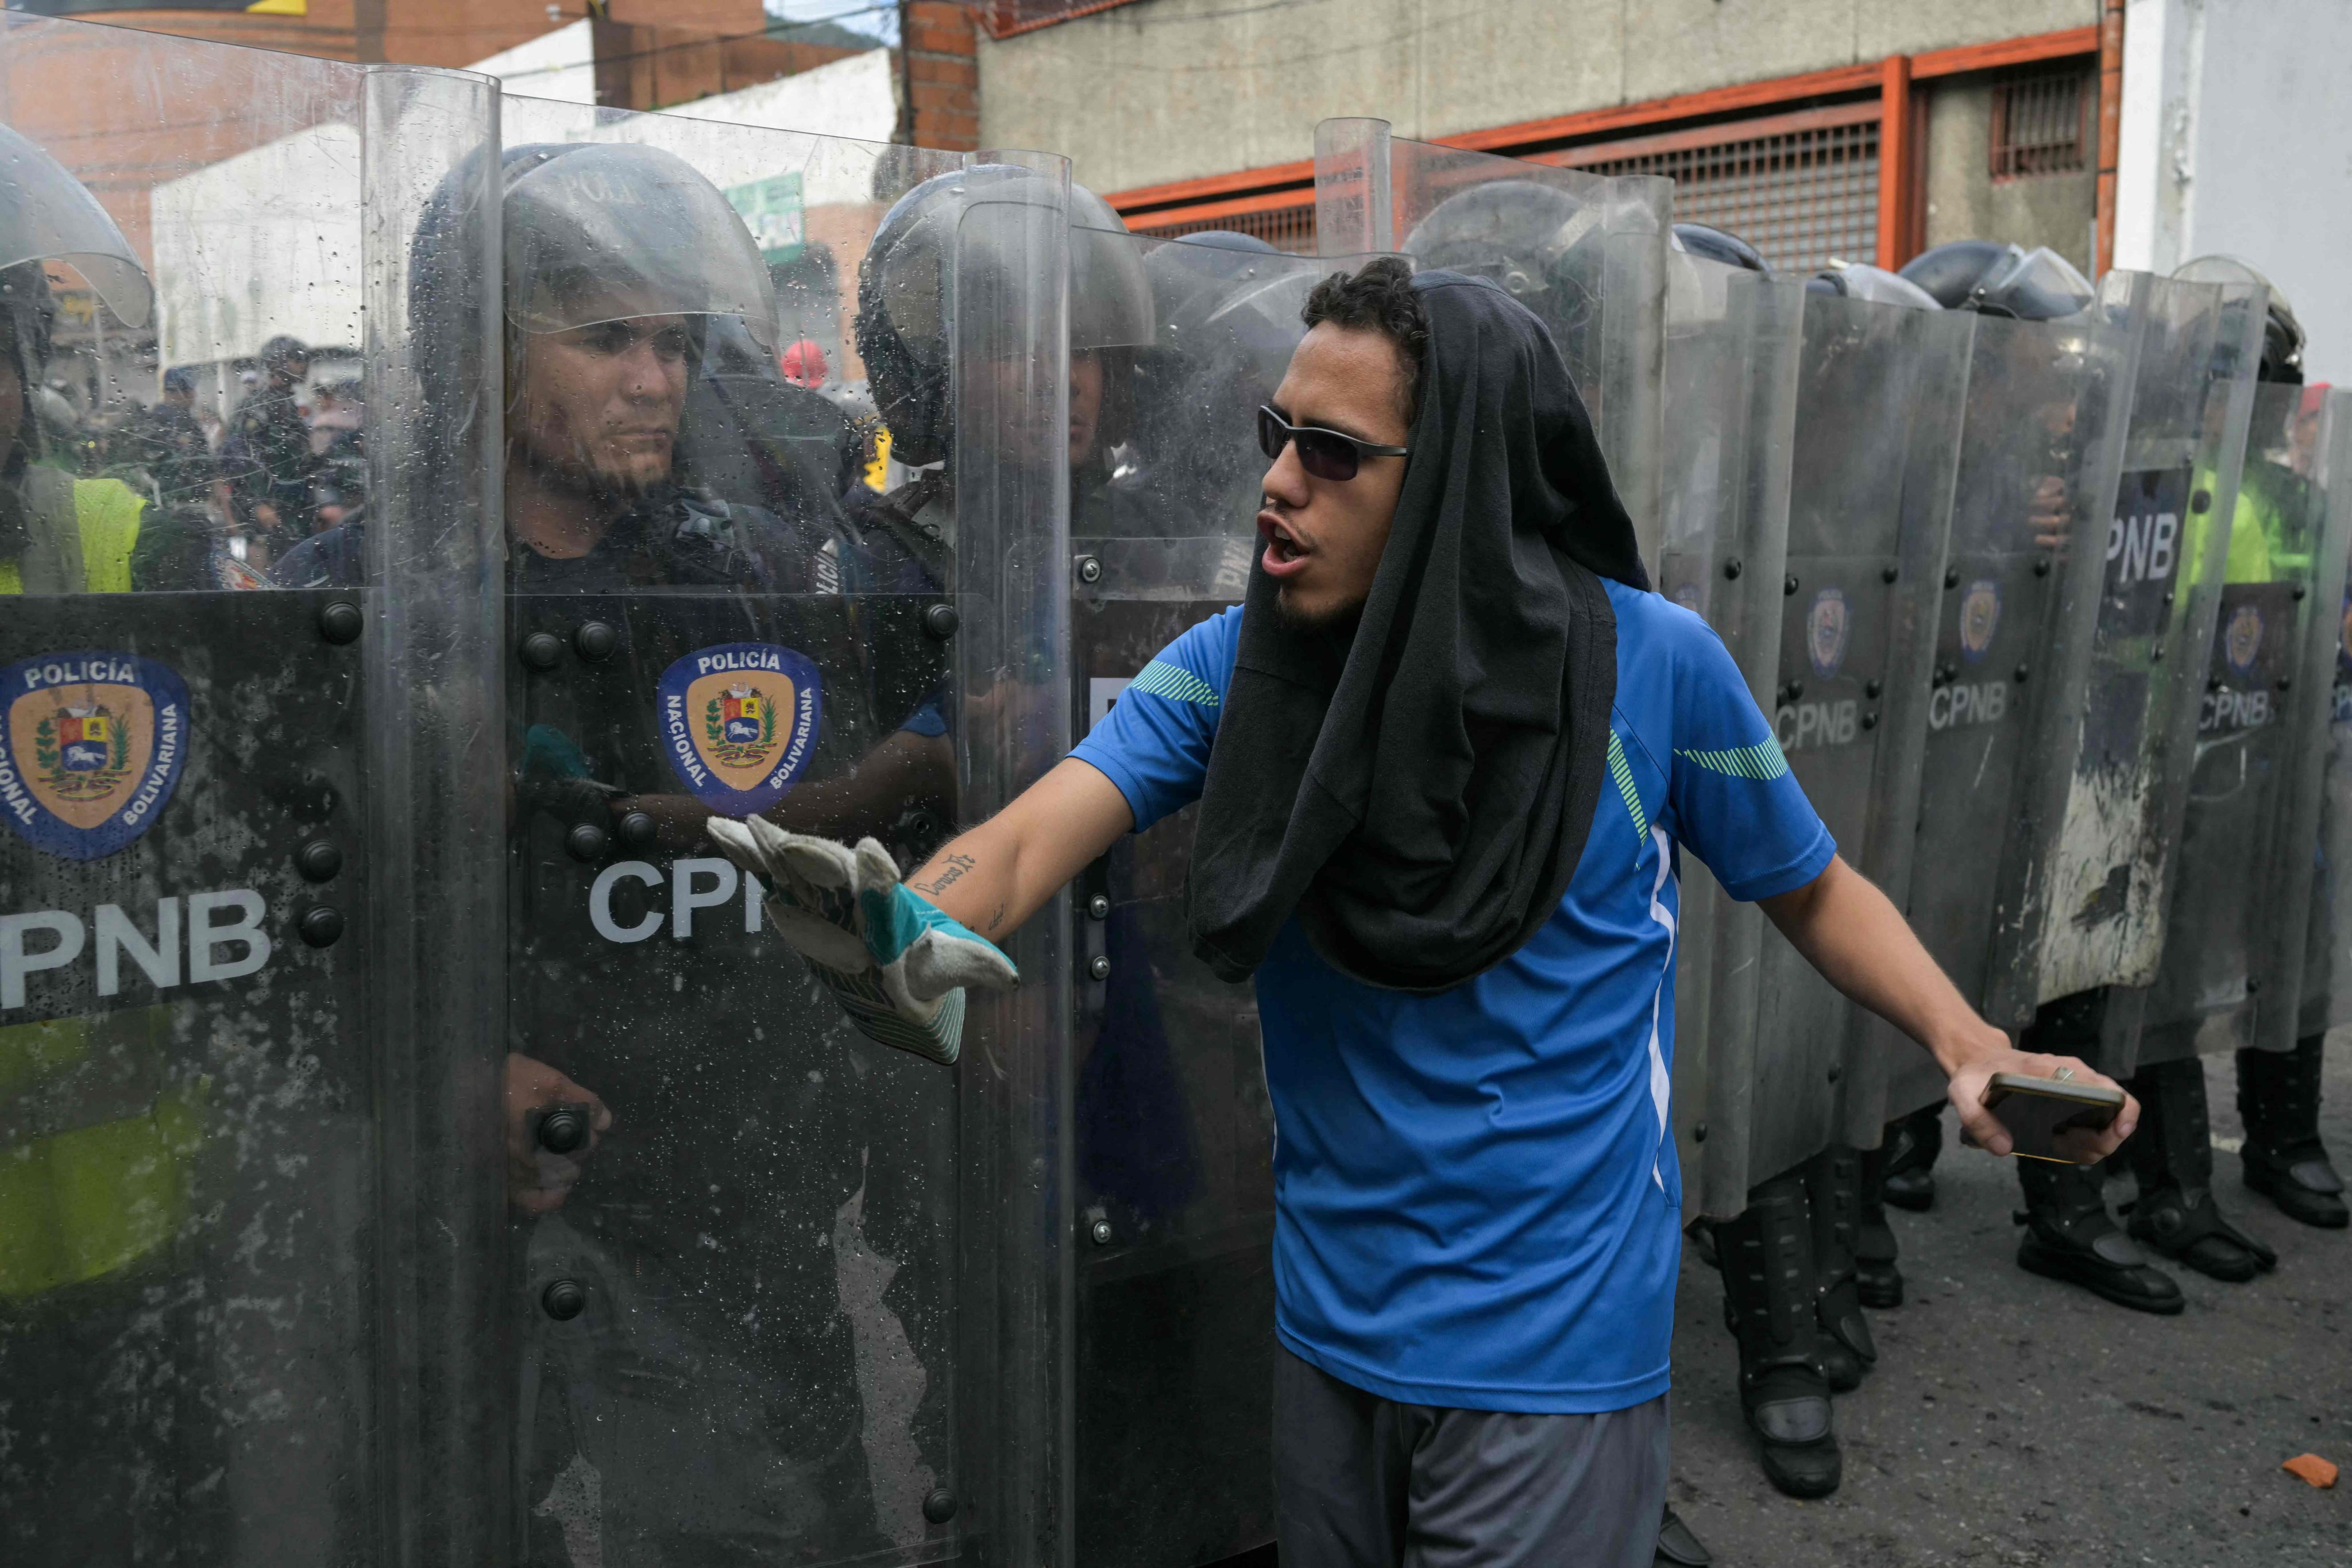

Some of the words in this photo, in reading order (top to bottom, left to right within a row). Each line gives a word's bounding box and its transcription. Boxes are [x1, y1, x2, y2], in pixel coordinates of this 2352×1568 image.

[24, 658, 135, 689] POLICÍA
[697, 648, 781, 674] POLICÍA
[1777, 700, 1857, 751] CPNB
[1929, 681, 2007, 730] CPNB
[2199, 690, 2268, 730] CPNB
[667, 696, 707, 787] NACIONAL
[770, 688, 813, 789] BOLIVARIANA
[123, 703, 176, 825] BOLIVARIANA
